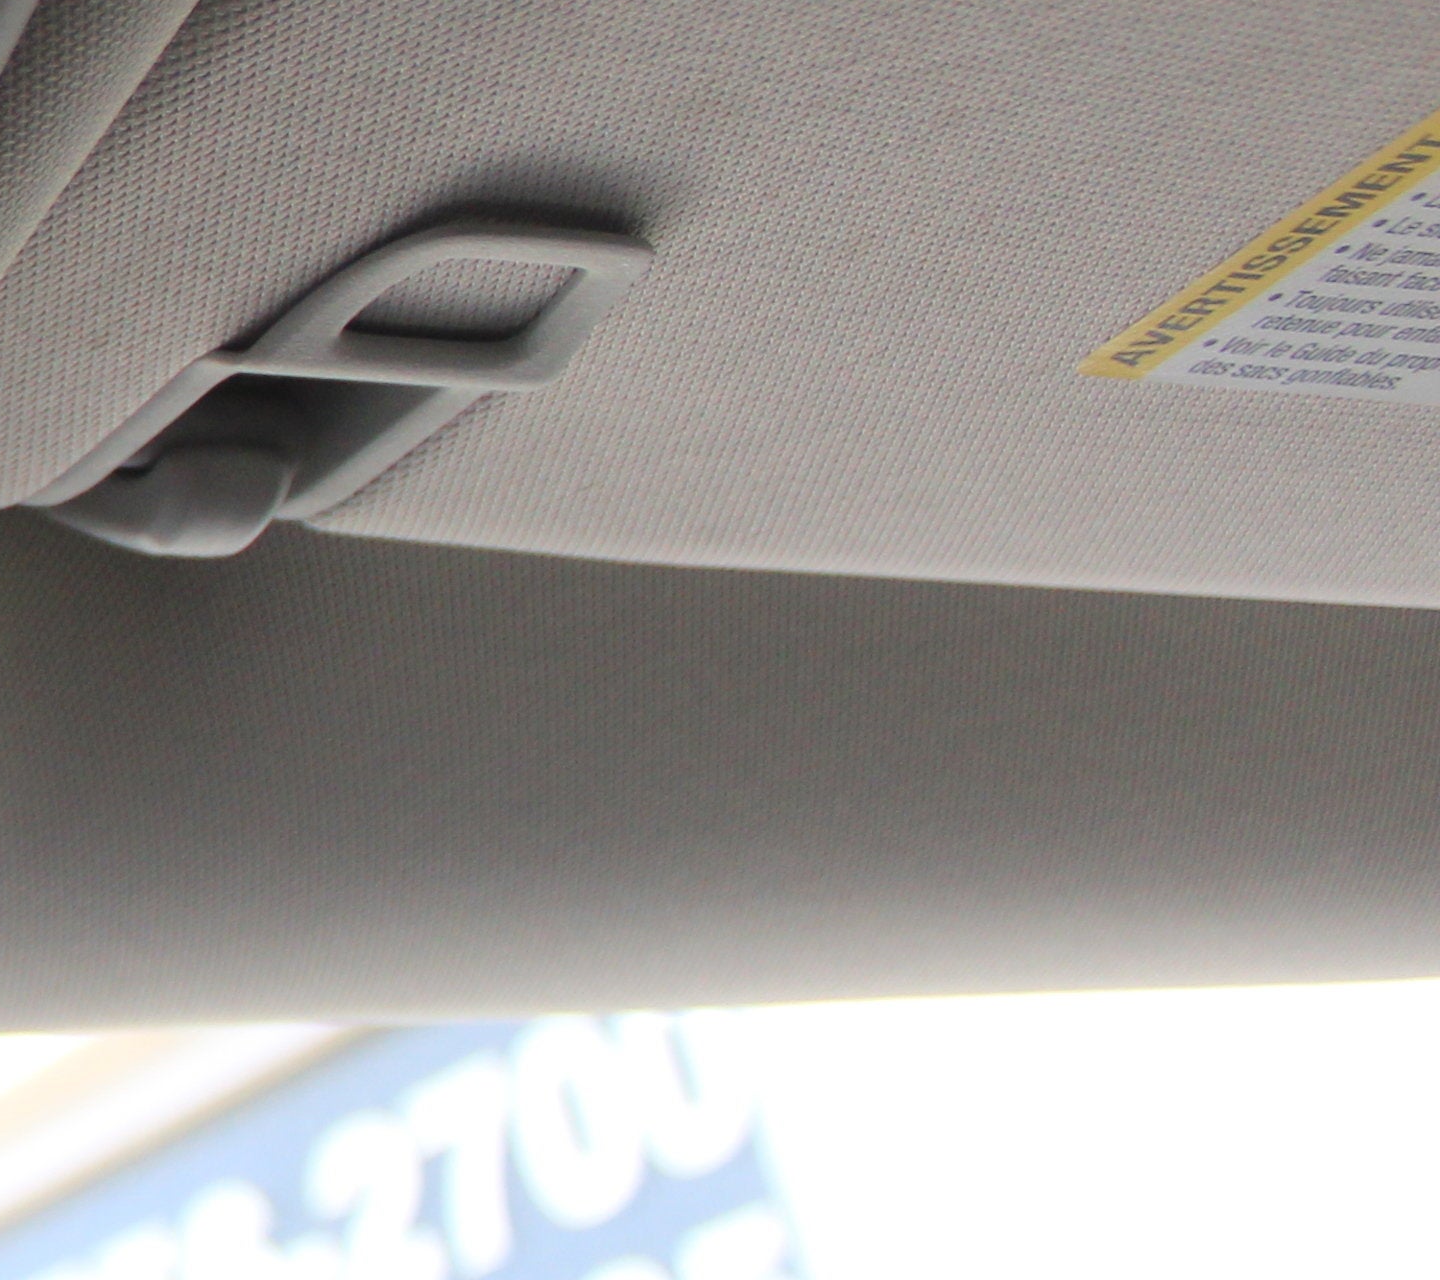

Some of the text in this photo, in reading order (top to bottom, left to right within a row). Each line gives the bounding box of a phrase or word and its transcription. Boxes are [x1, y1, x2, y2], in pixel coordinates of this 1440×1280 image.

[1283, 289, 1384, 315] Toujours
[1251, 314, 1342, 335] retenue
[1332, 321, 1399, 340] pour
[1219, 335, 1269, 356] Voir
[1289, 342, 1358, 364] Guide
[1354, 348, 1389, 366] du
